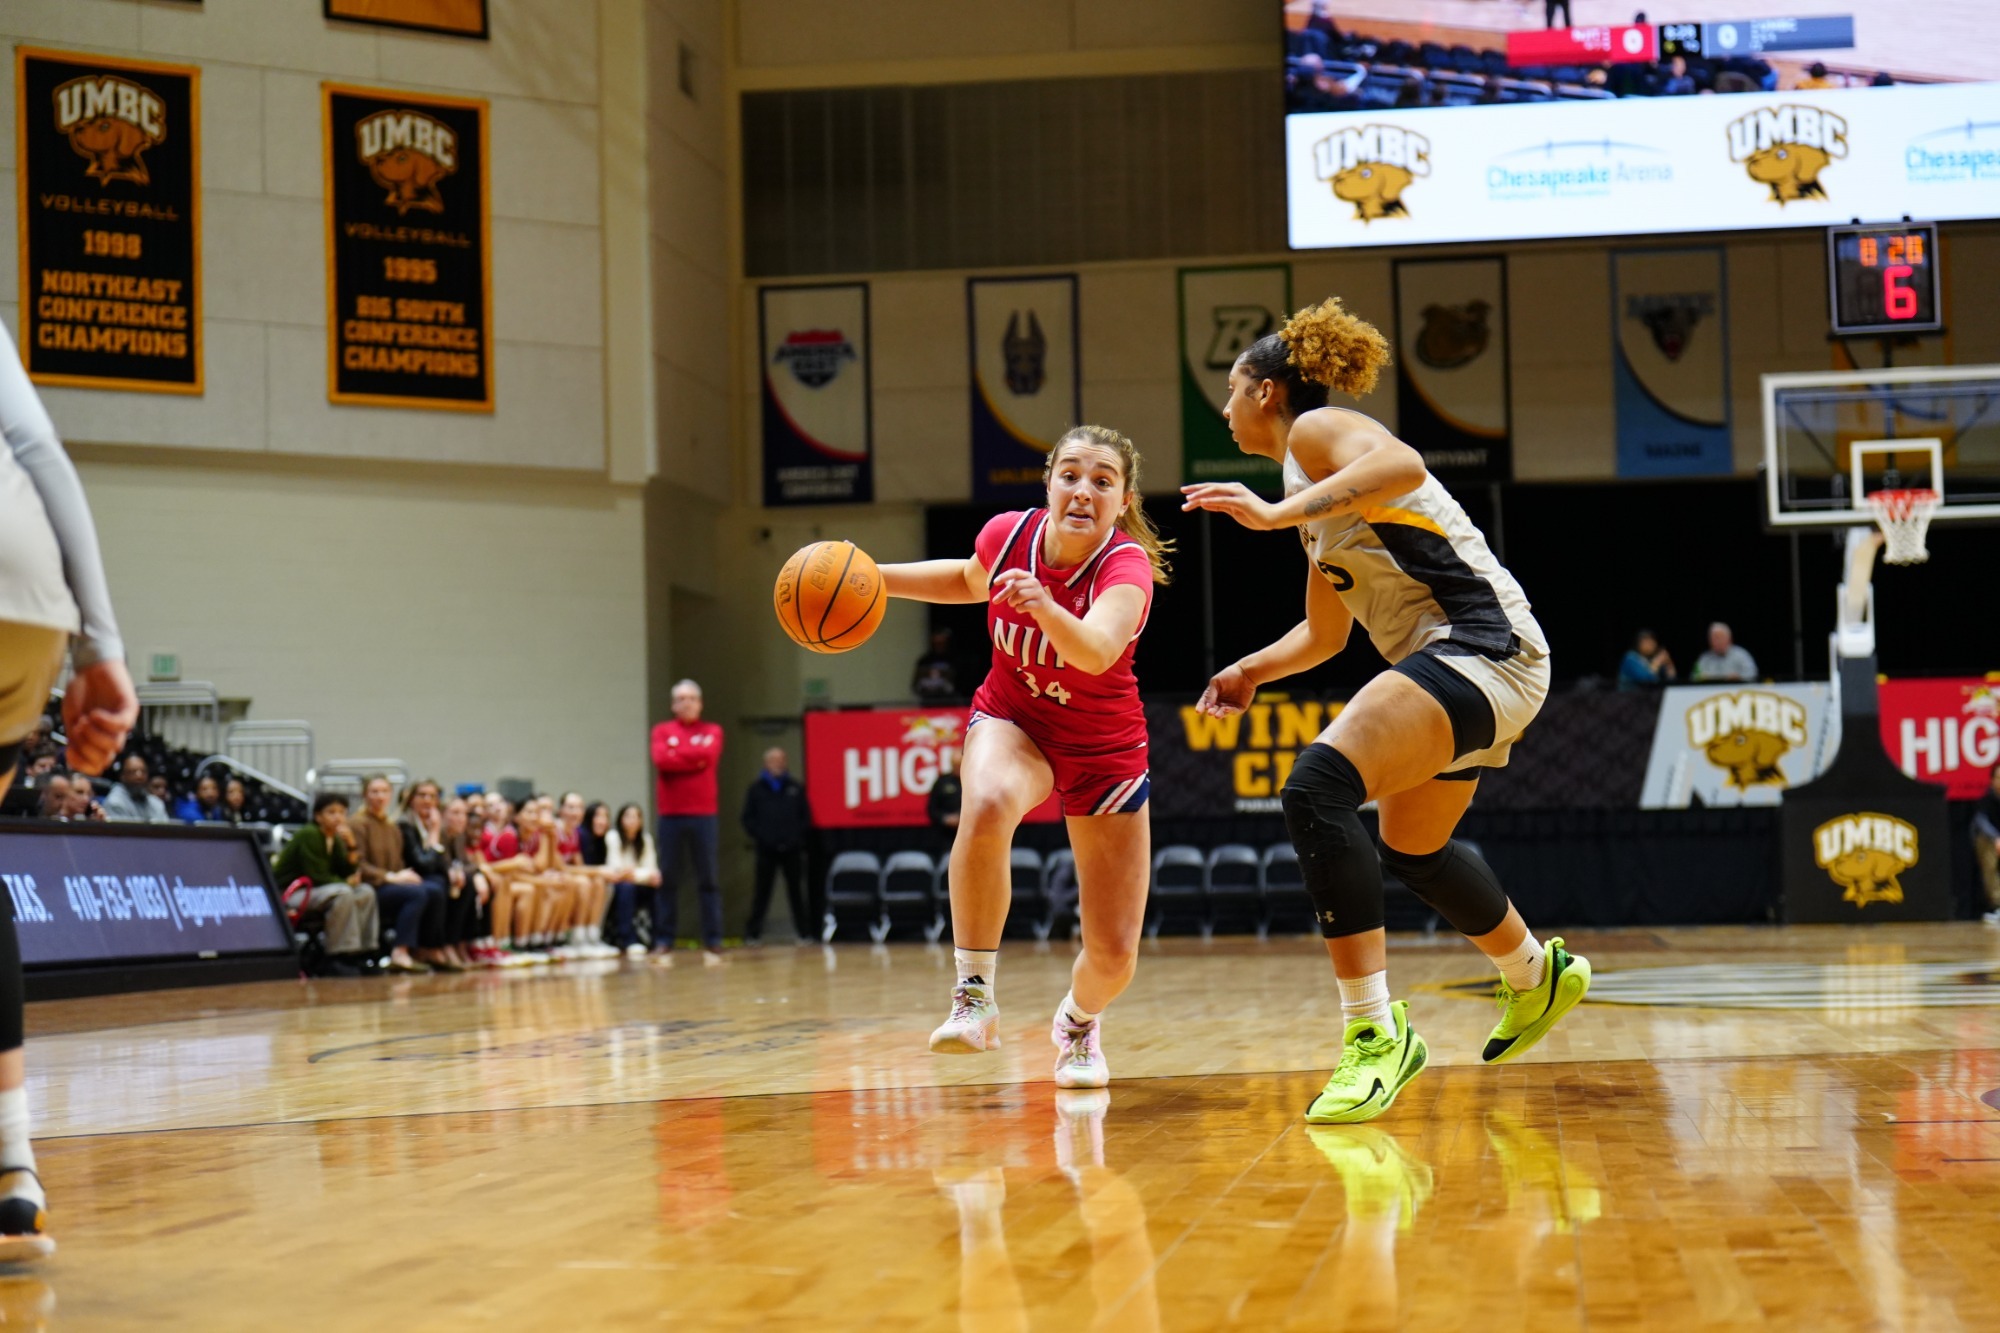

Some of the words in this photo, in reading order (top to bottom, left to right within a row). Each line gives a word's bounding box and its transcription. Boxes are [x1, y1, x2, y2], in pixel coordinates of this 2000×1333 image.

[57, 80, 161, 138] UMBC
[360, 113, 454, 168] UMBC
[1727, 104, 1848, 162] UMBC
[1313, 123, 1431, 181] UMBC
[1488, 164, 1610, 194] Chesapeake
[1615, 161, 1675, 182] Arena
[40, 193, 178, 221] VOLLEYBALL
[345, 223, 471, 248] VOLLEYBALL
[42, 269, 182, 303] NORTHEAST
[1884, 265, 1917, 319] 6
[39, 295, 187, 330] CONFERENCE
[396, 299, 465, 325] SOUTH
[38, 323, 187, 359] CHAMPIONS
[344, 319, 477, 350] CONFERENCE
[344, 345, 478, 378] CHAMPIONS
[1688, 693, 1805, 745] UMBC
[1818, 817, 1916, 865] UMBC
[2, 874, 54, 923] TAS.
